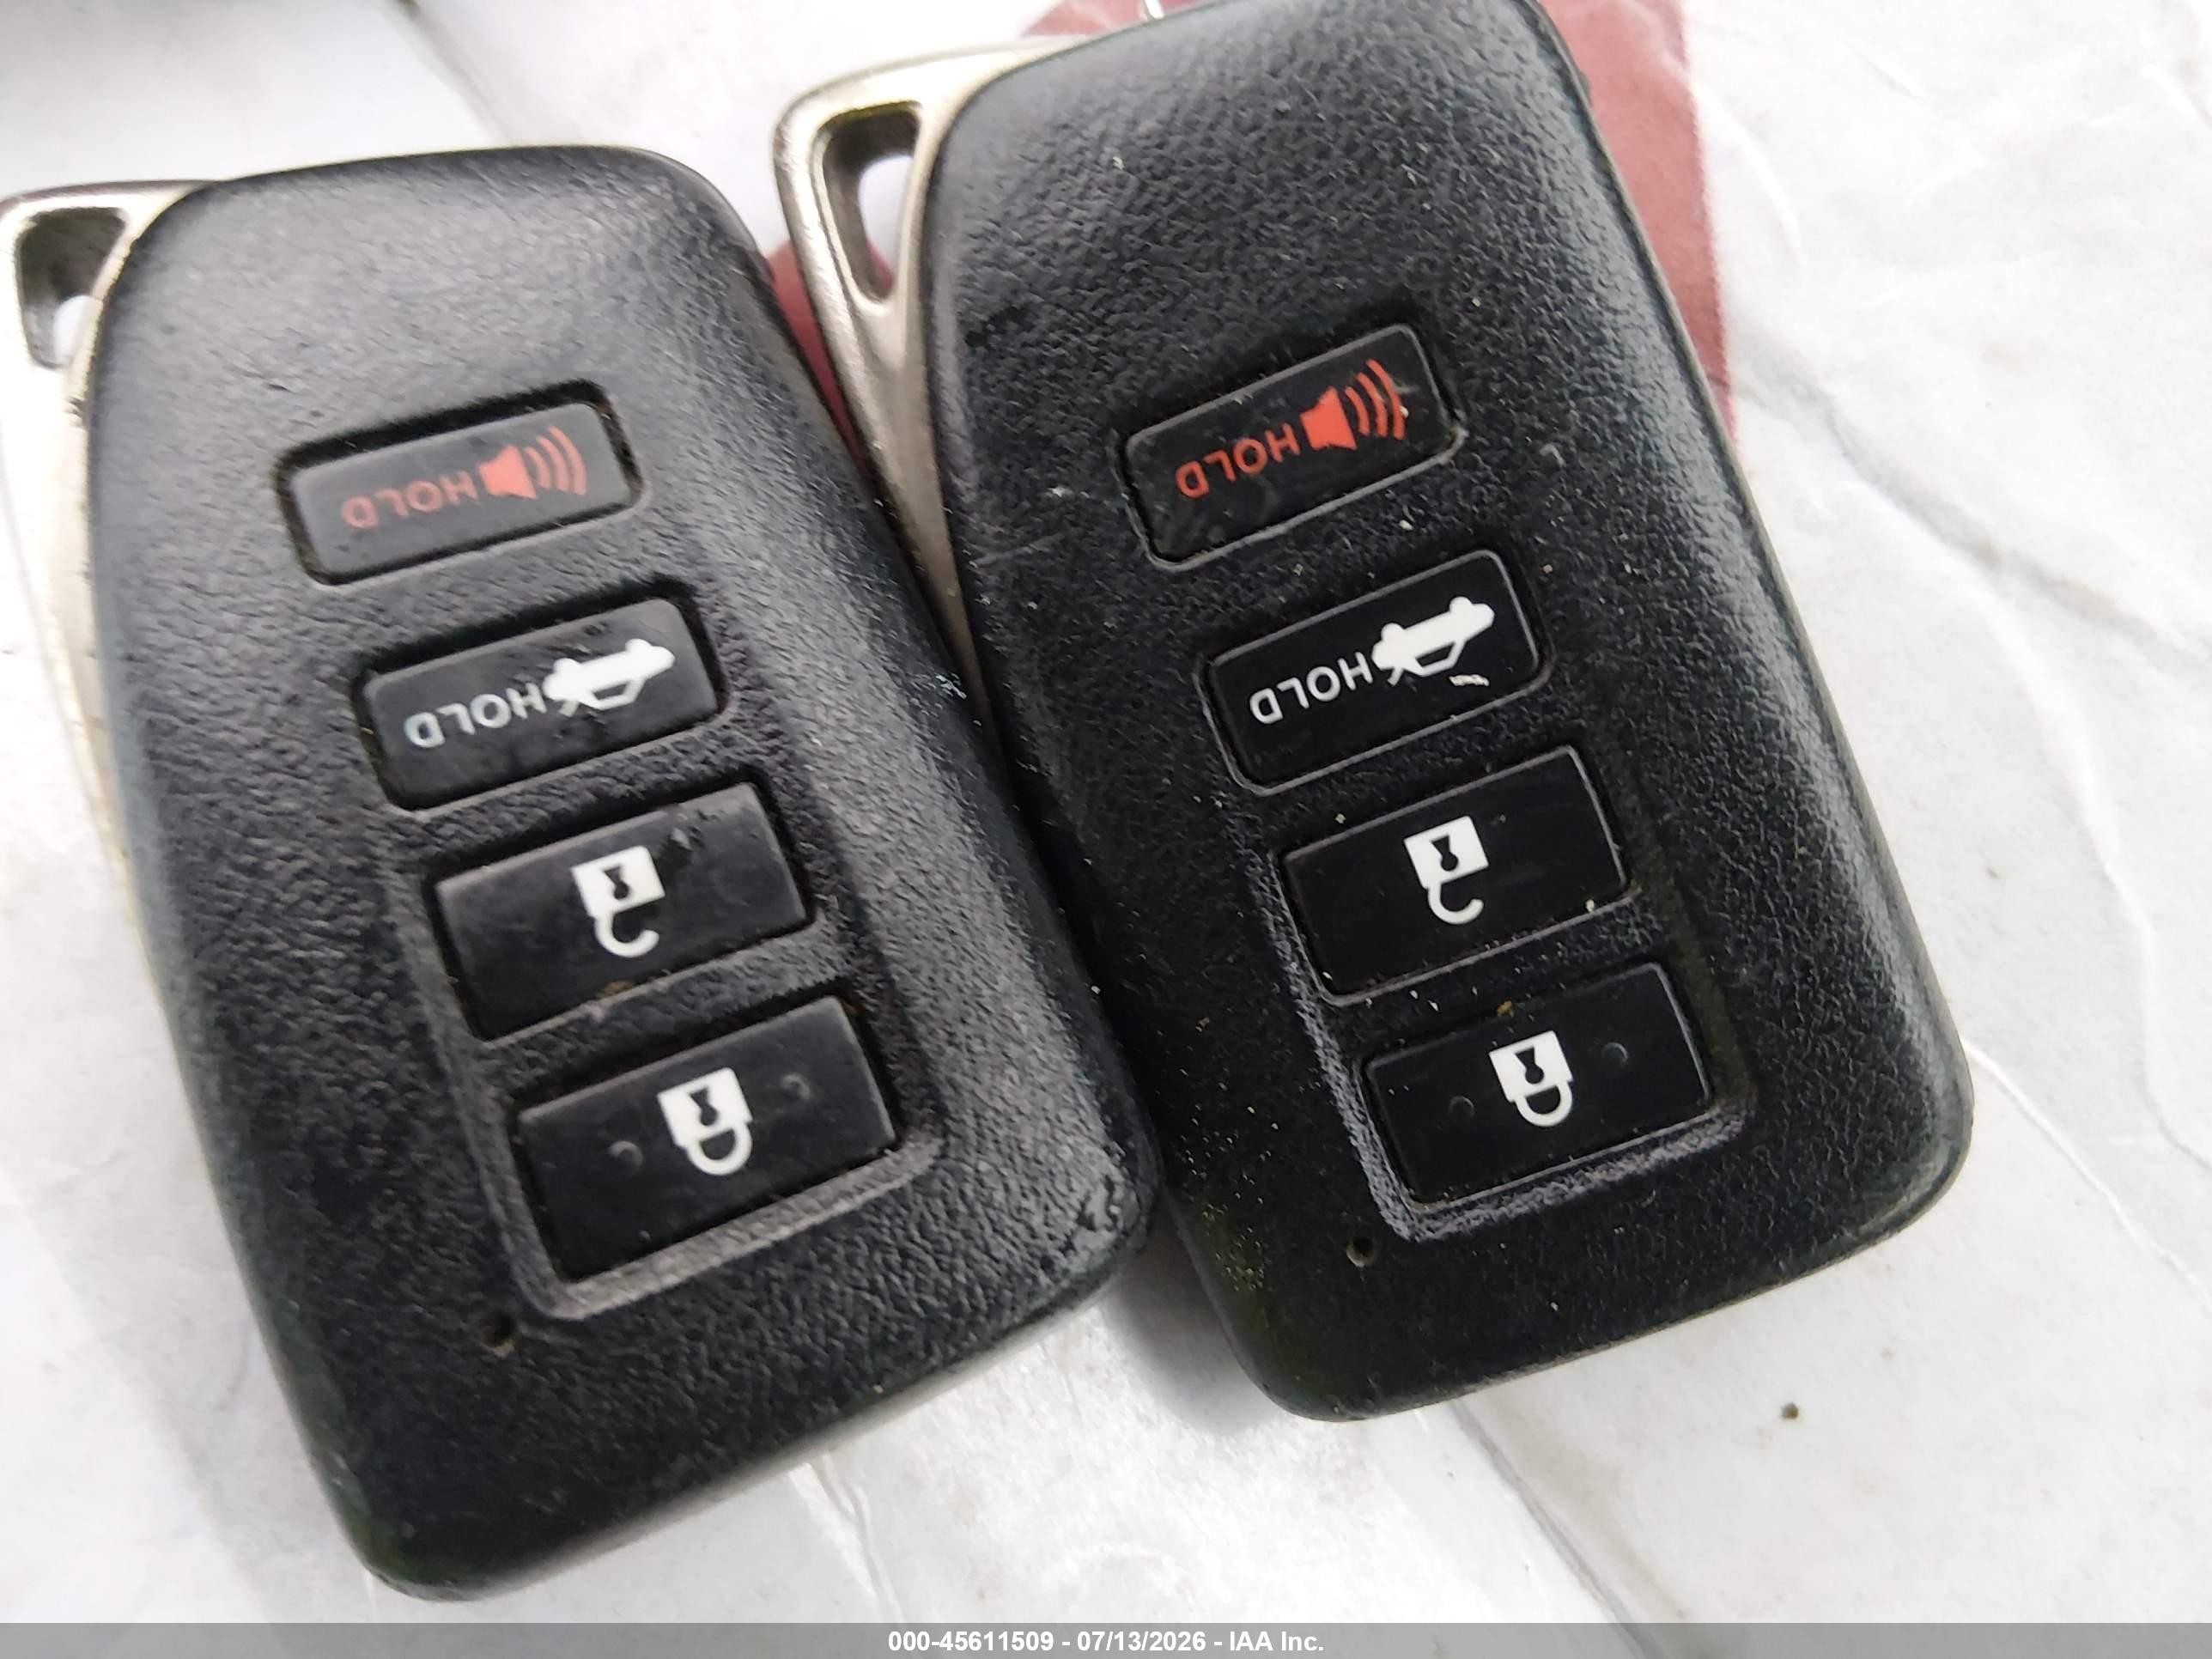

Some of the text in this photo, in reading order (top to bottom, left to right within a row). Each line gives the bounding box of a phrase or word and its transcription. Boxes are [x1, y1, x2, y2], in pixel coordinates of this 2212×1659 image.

[1176, 422, 1301, 499] HOLD
[341, 470, 478, 530] HOLD
[404, 683, 548, 749] HOLD
[1249, 651, 1374, 725] HOLD
